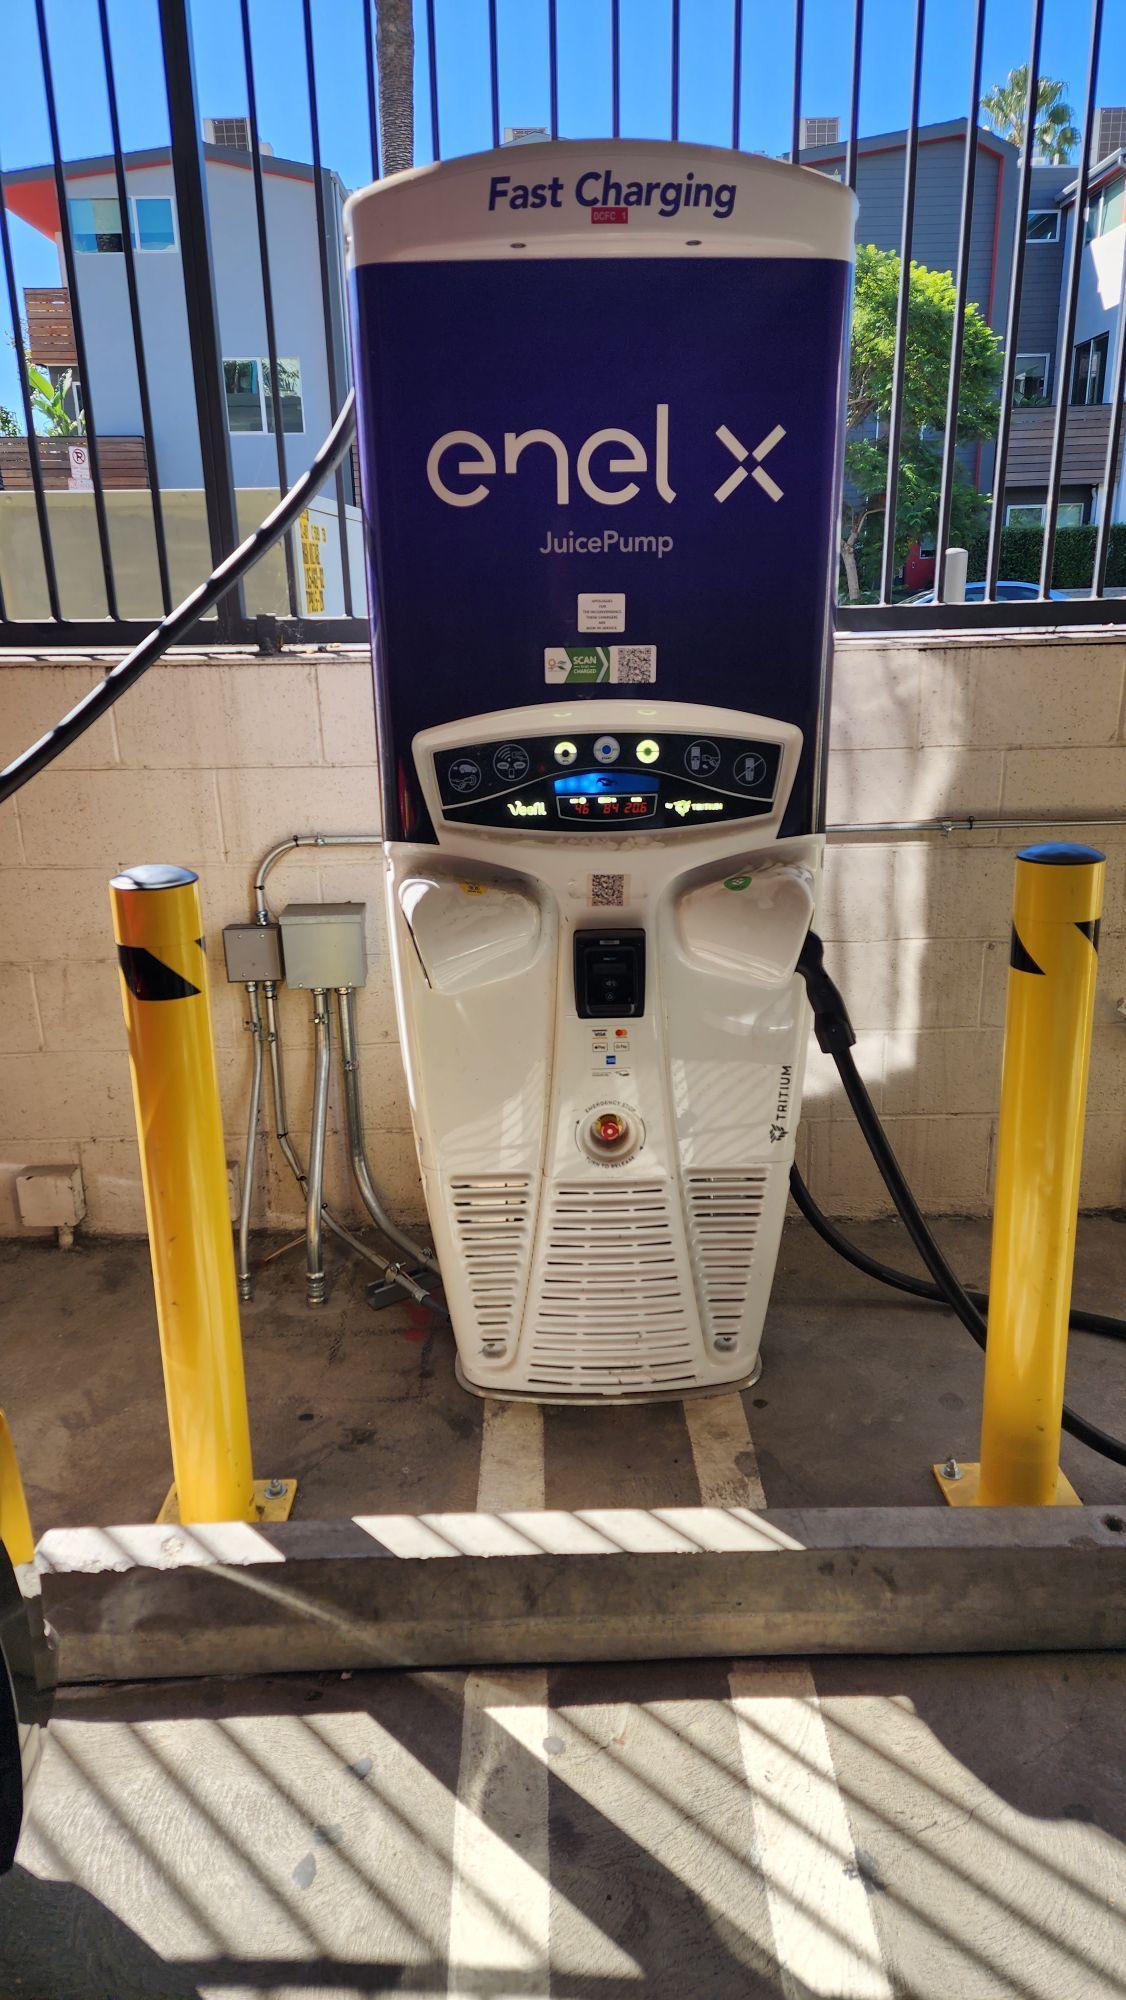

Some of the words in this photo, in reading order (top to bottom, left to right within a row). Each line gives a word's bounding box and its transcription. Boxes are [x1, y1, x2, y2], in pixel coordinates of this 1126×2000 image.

[488, 175, 564, 211] Fast
[575, 169, 737, 219] Charging
[592, 211, 616, 222] DCFC
[426, 403, 677, 507] enel
[540, 530, 673, 558] JuicePump
[573, 656, 597, 665] SCAN
[776, 1065, 792, 1121] TRITIUM
[585, 1099, 621, 1113] EMERGENCY
[621, 1101, 637, 1113] STOP
[610, 1155, 635, 1169] RELEASE
